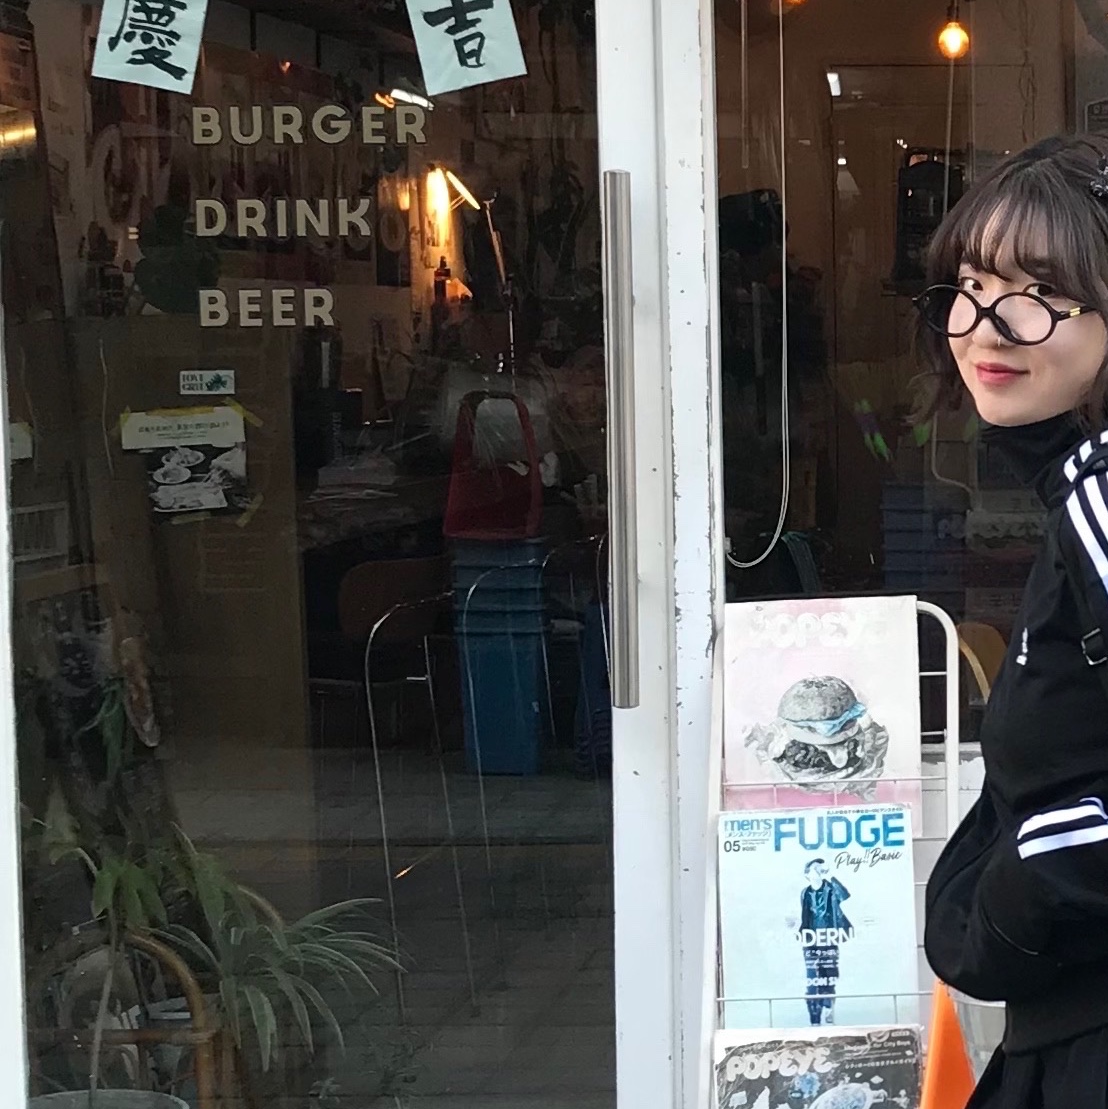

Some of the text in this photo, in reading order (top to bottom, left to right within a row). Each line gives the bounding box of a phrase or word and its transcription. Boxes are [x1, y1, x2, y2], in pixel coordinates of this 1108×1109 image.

[191, 105, 427, 145] BURGER
[195, 198, 373, 237] DRINK
[199, 288, 335, 327] BEER
[723, 840, 741, 852] 05
[774, 813, 905, 852] FUDGE
[726, 1046, 832, 1082] POPEYE
